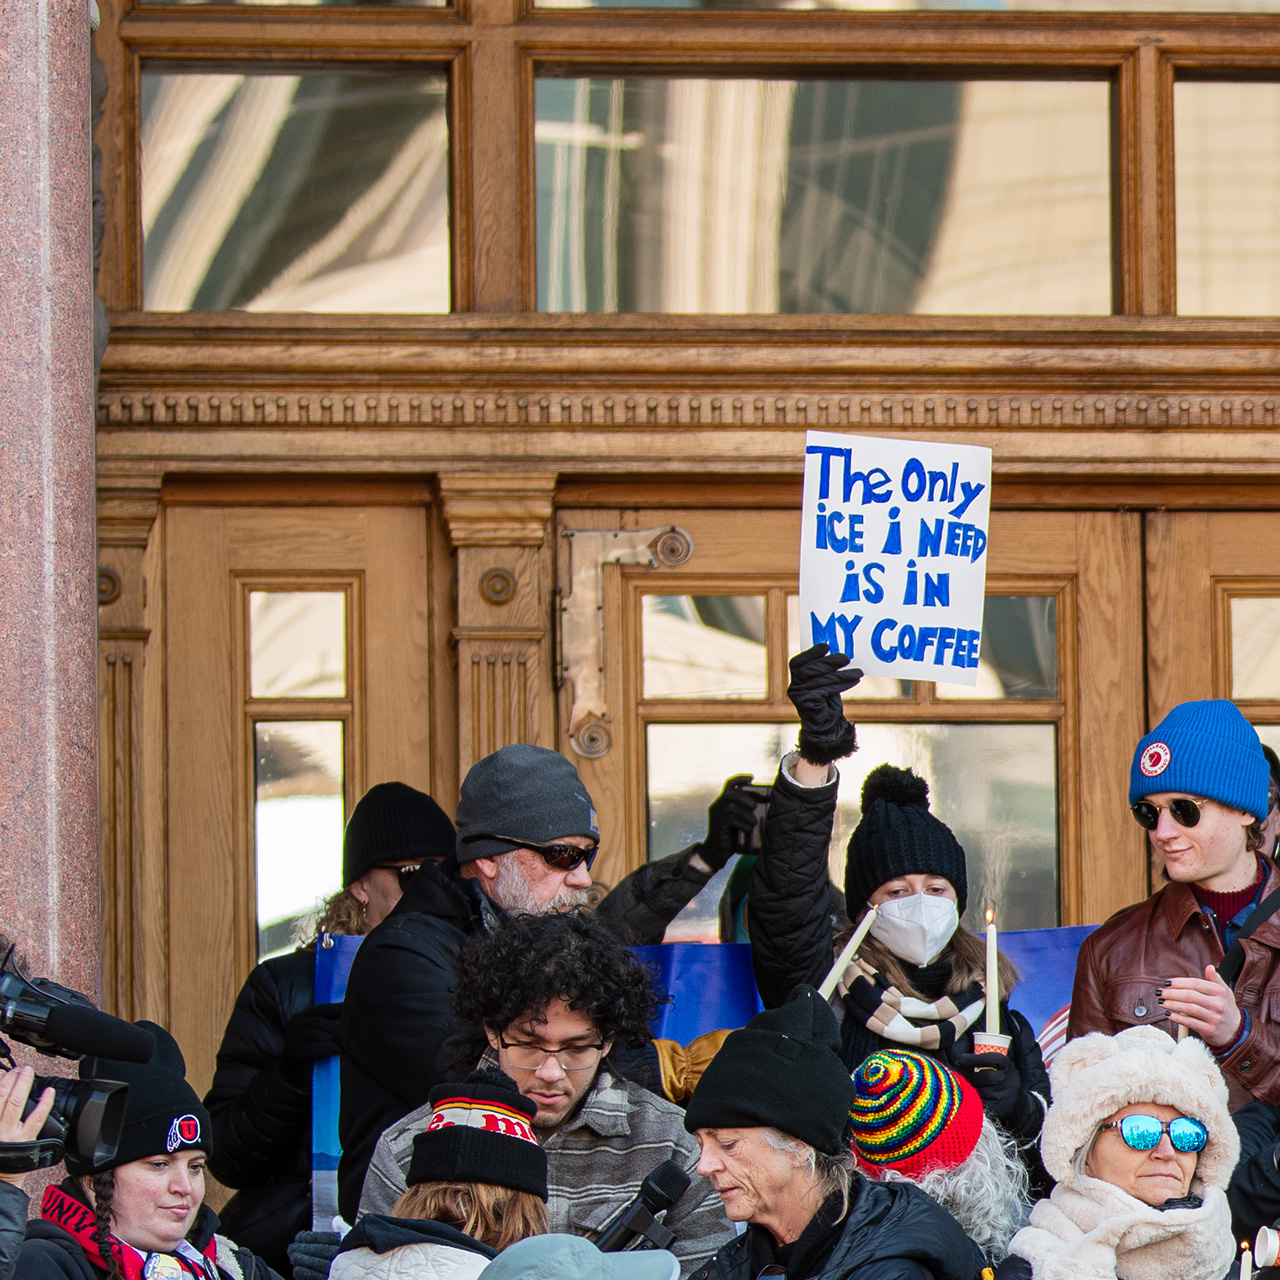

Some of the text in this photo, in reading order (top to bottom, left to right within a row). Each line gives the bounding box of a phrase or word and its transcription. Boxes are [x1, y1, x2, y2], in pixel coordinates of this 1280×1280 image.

[806, 446, 985, 519] The Only
[918, 518, 987, 564] NEED
[810, 611, 980, 669] MY COFFEE
[180, 1120, 197, 1140] U
